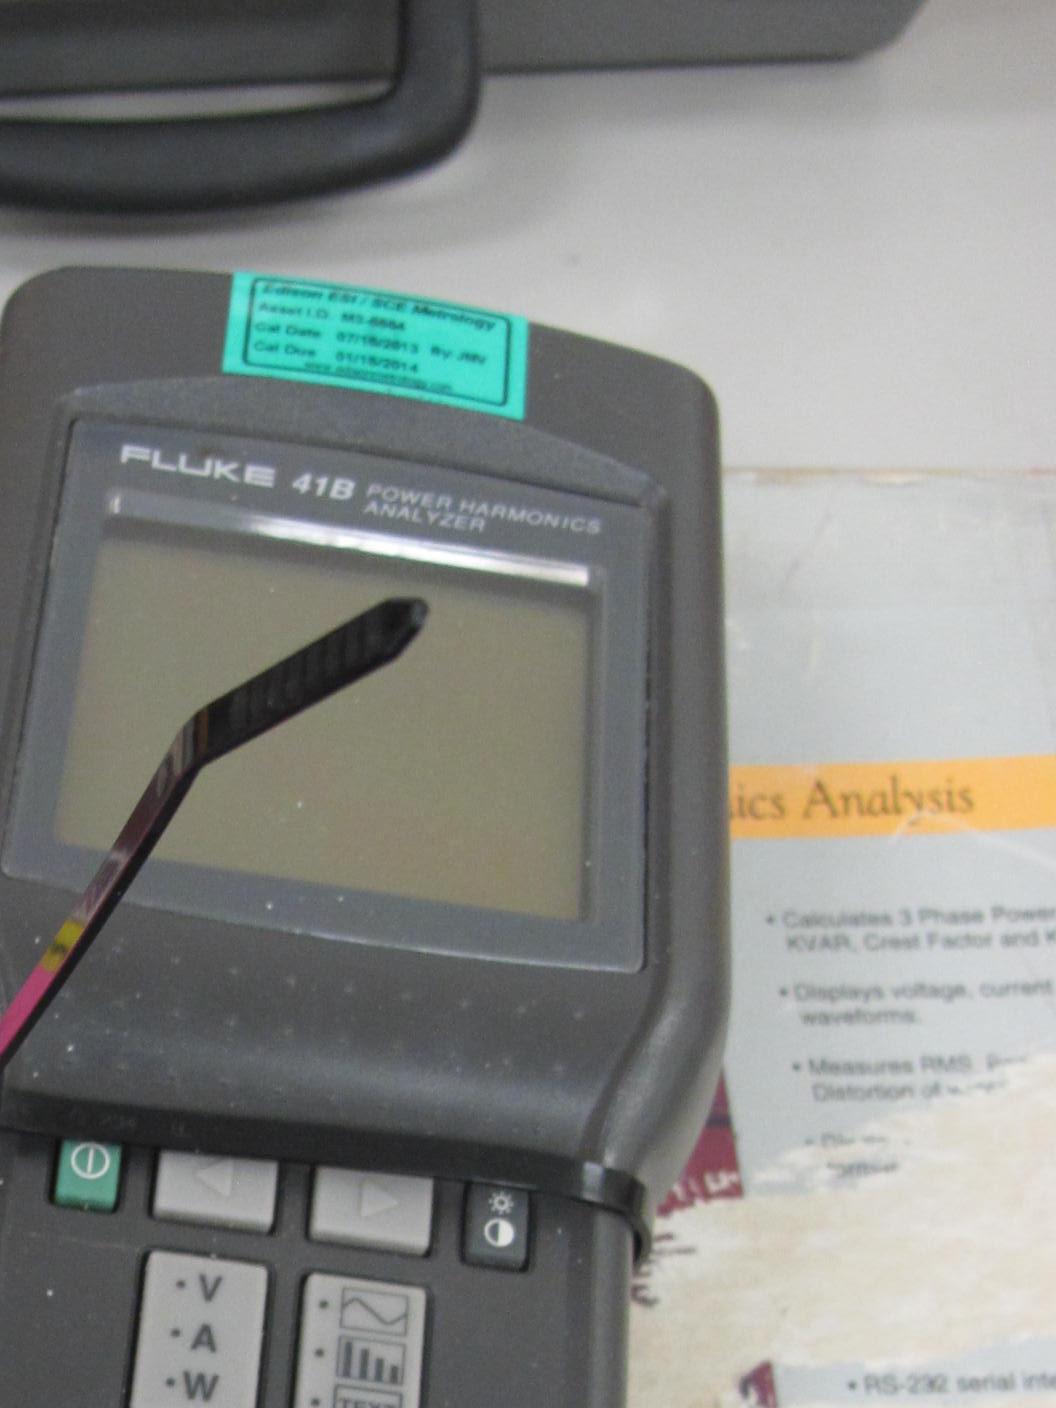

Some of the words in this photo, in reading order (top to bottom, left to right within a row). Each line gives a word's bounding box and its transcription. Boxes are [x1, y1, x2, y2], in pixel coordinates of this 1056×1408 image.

[120, 445, 277, 488] FLUKE
[291, 472, 357, 502] 41B
[365, 482, 456, 512] POWER
[459, 490, 604, 536] HARMONICS
[362, 502, 487, 533] ANALYZER
[801, 773, 977, 827] Analysis
[782, 909, 893, 928] Calculates
[917, 906, 985, 924] Phase
[794, 982, 884, 1003] Displays
[808, 1057, 914, 1075] Measures
[199, 1273, 223, 1301] V
[190, 1323, 218, 1354] A
[182, 1370, 220, 1402] W
